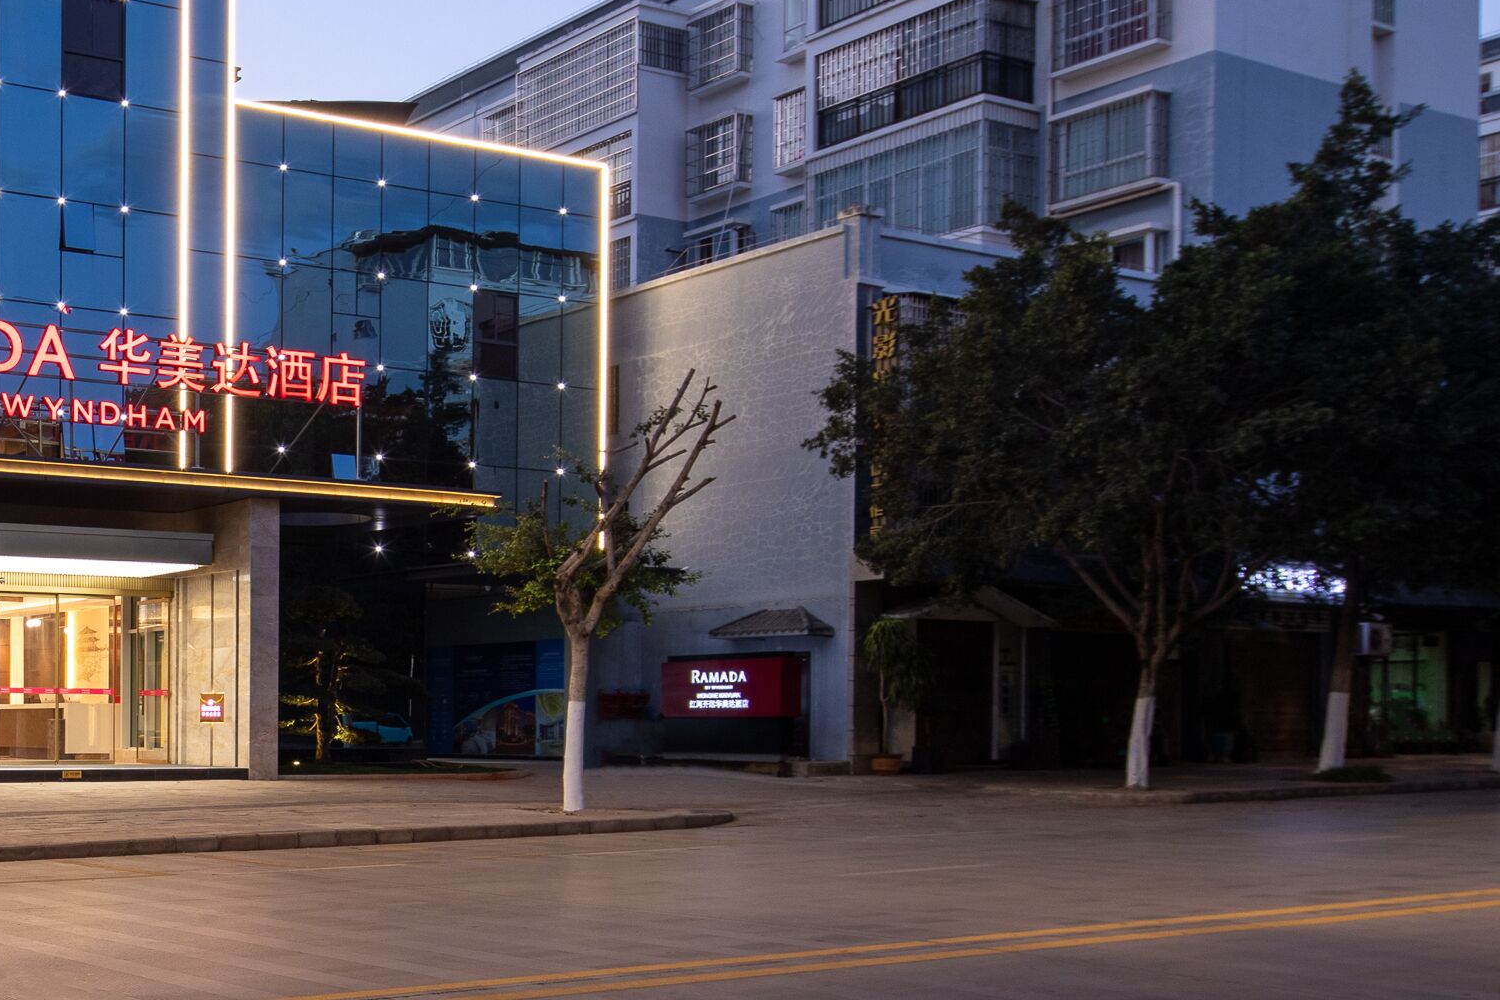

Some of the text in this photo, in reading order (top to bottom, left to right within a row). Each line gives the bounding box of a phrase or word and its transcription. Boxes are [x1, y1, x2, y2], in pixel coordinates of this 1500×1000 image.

[98, 326, 367, 407] 华美达酒店
[1, 391, 207, 434] WYNDHAM
[690, 669, 747, 683] RAMADA
